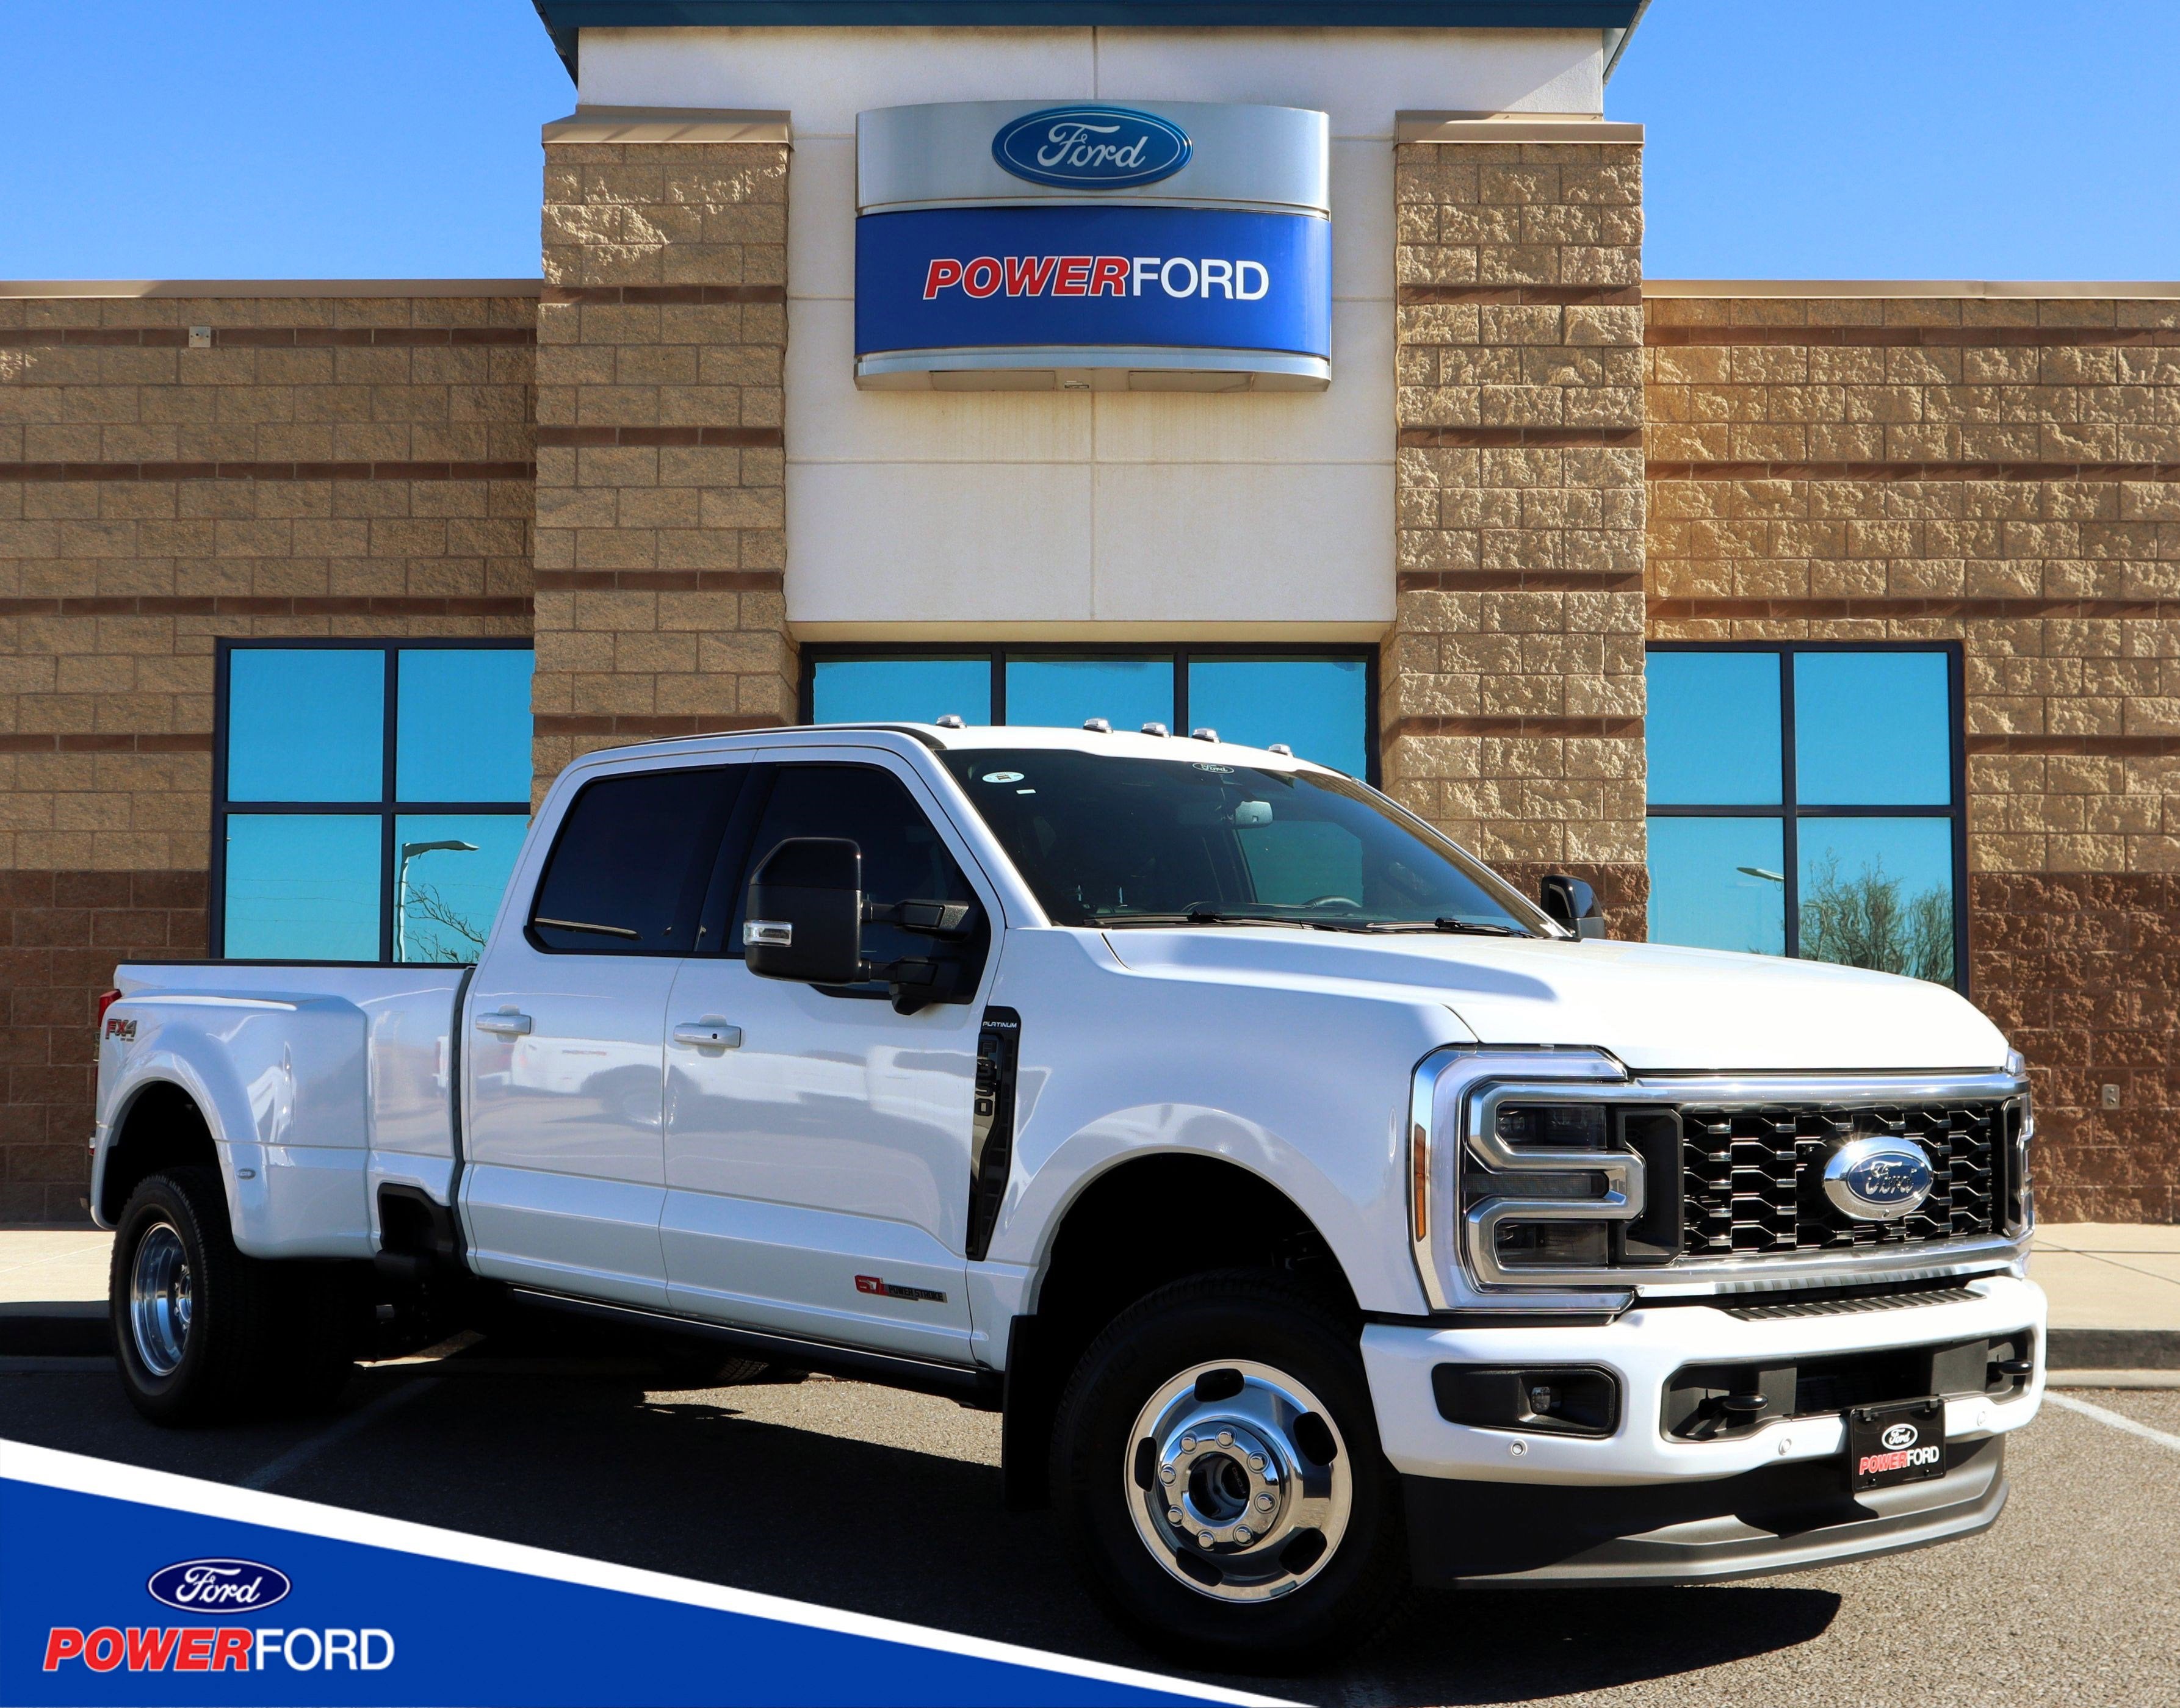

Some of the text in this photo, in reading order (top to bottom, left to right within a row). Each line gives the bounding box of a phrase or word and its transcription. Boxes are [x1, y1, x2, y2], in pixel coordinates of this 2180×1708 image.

[1038, 122, 1149, 168] Ford
[922, 256, 1269, 301] POWERFORD
[1200, 762, 1229, 772] Ford
[105, 1018, 138, 1040] FX4
[1865, 1160, 1918, 1195] Ford
[1889, 1428, 1911, 1445] Ford
[1858, 1446, 1940, 1476] POWERFORD
